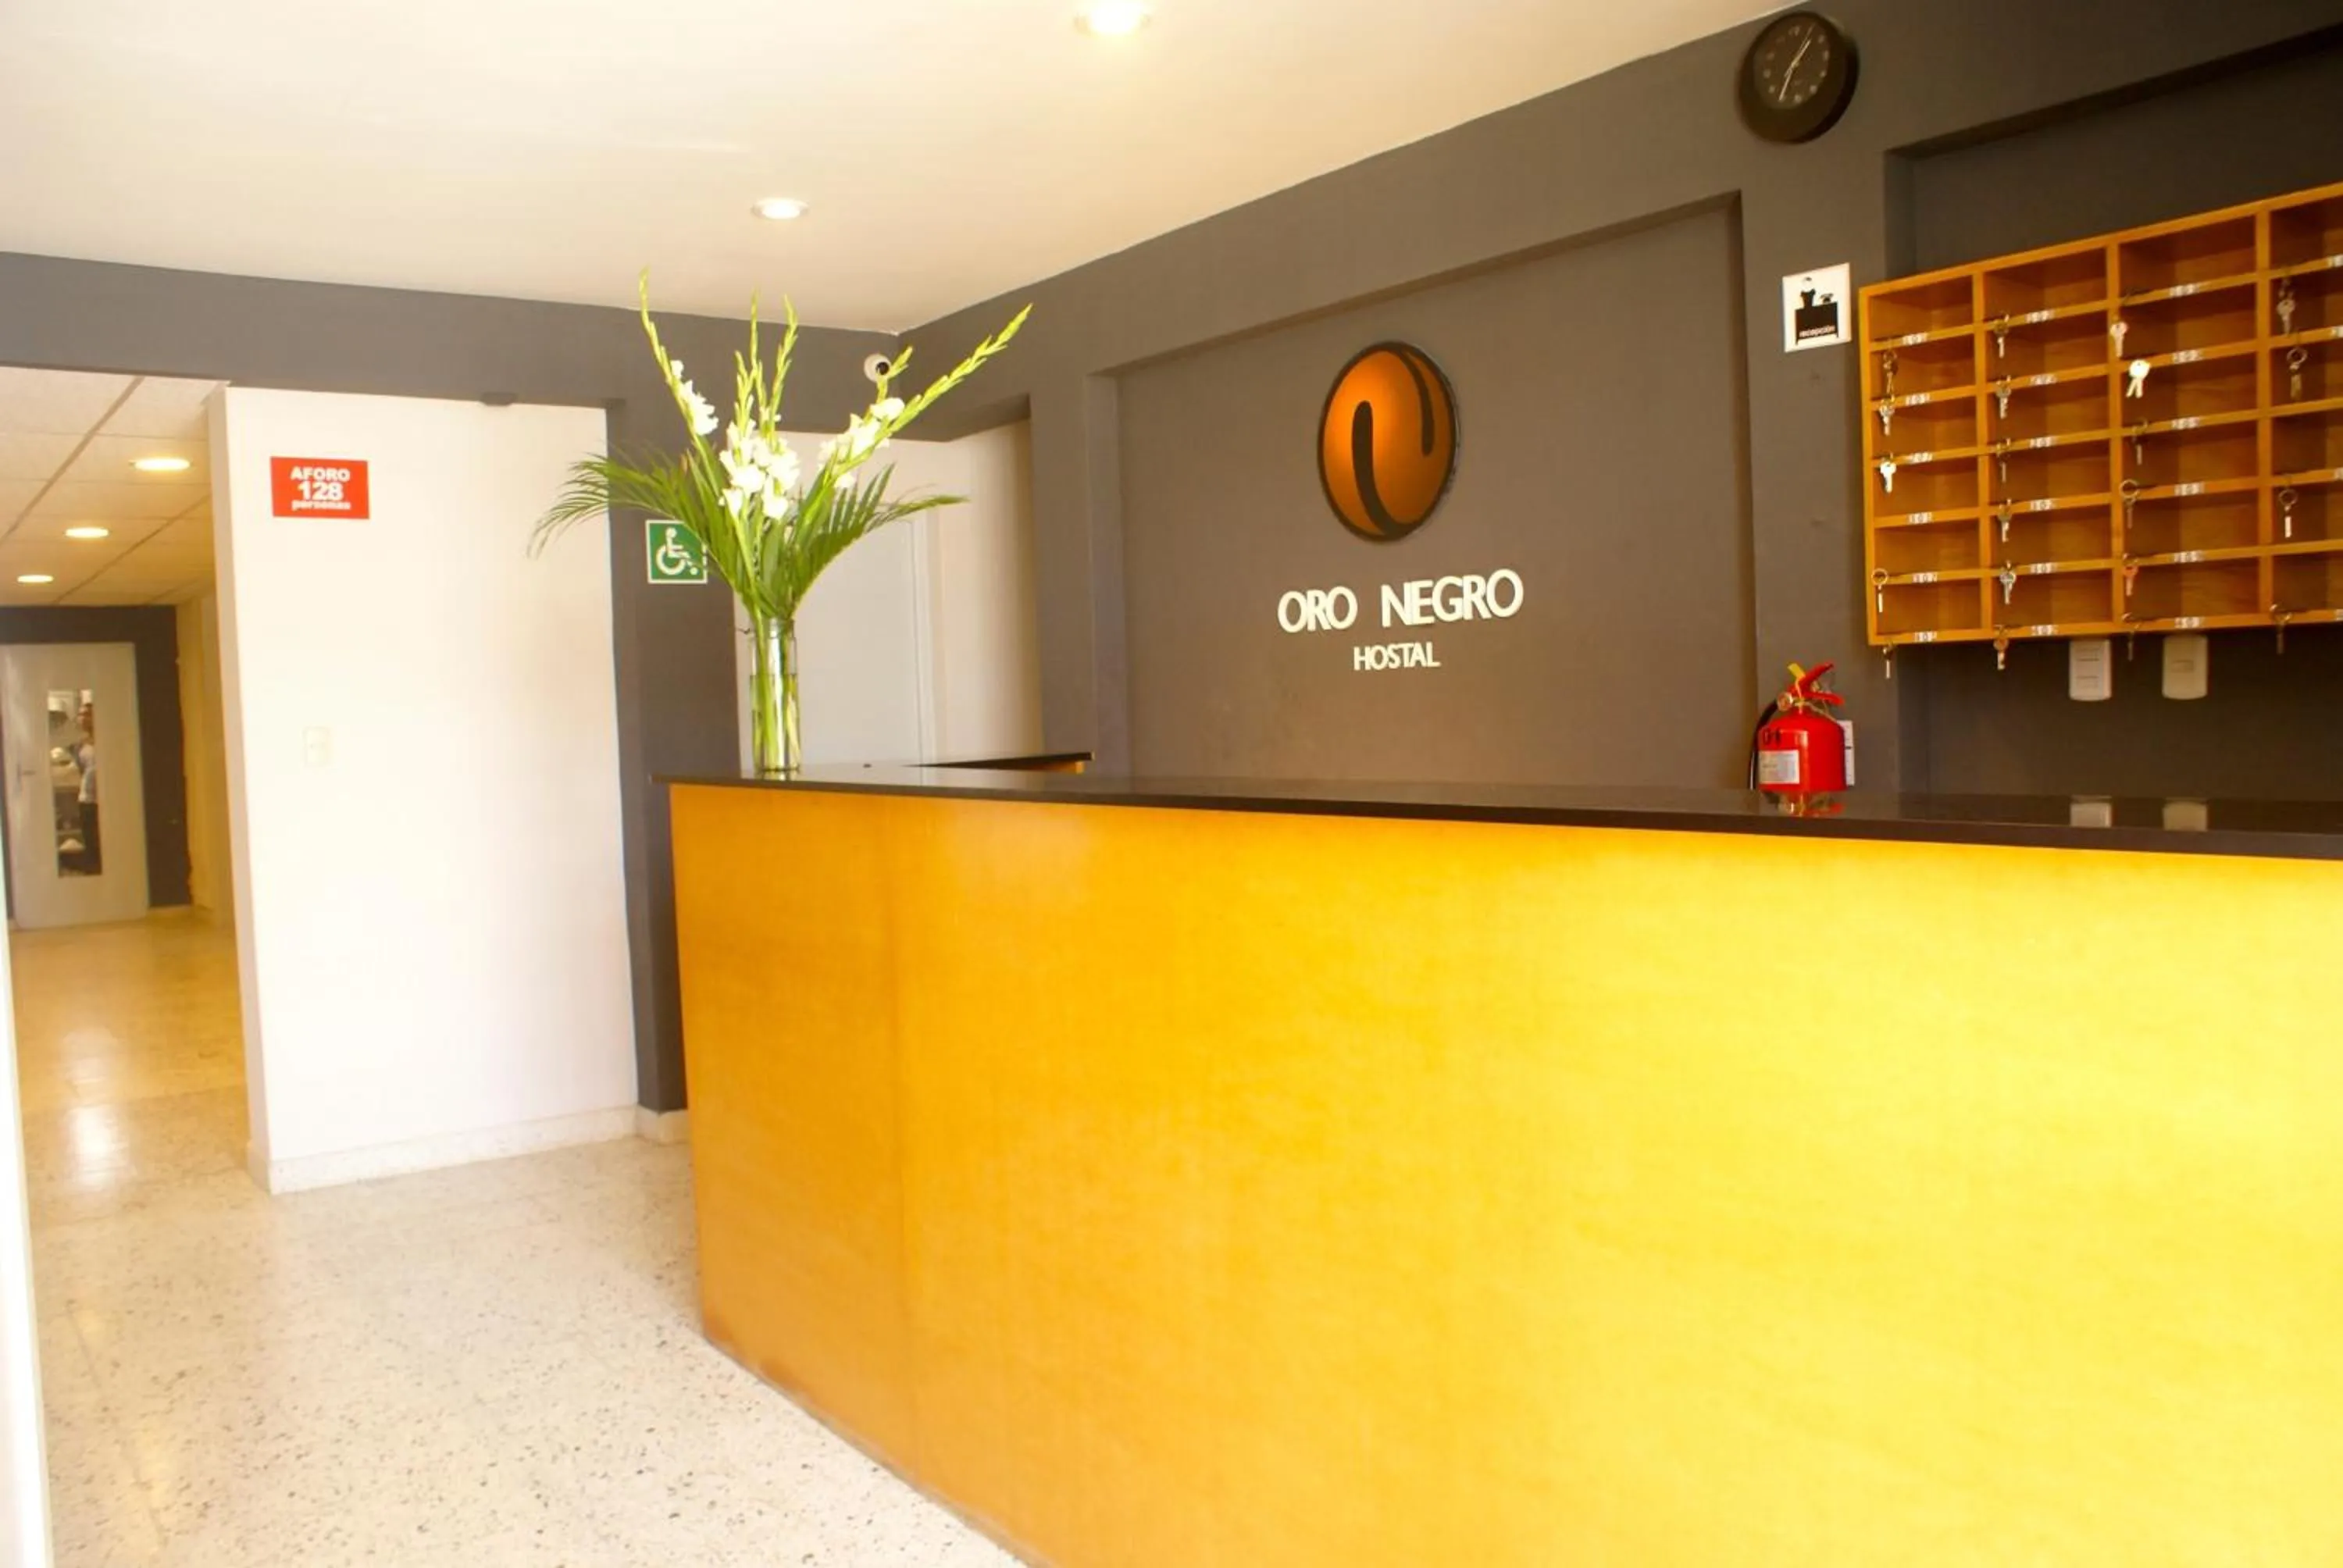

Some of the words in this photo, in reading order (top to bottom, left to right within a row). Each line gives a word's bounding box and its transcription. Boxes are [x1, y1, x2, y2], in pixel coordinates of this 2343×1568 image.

[291, 467, 351, 482] AFORO
[298, 481, 344, 501] 128
[1277, 586, 1358, 633] ORO
[1380, 568, 1524, 627] NEGRO
[1353, 642, 1441, 671] HOSTAL
